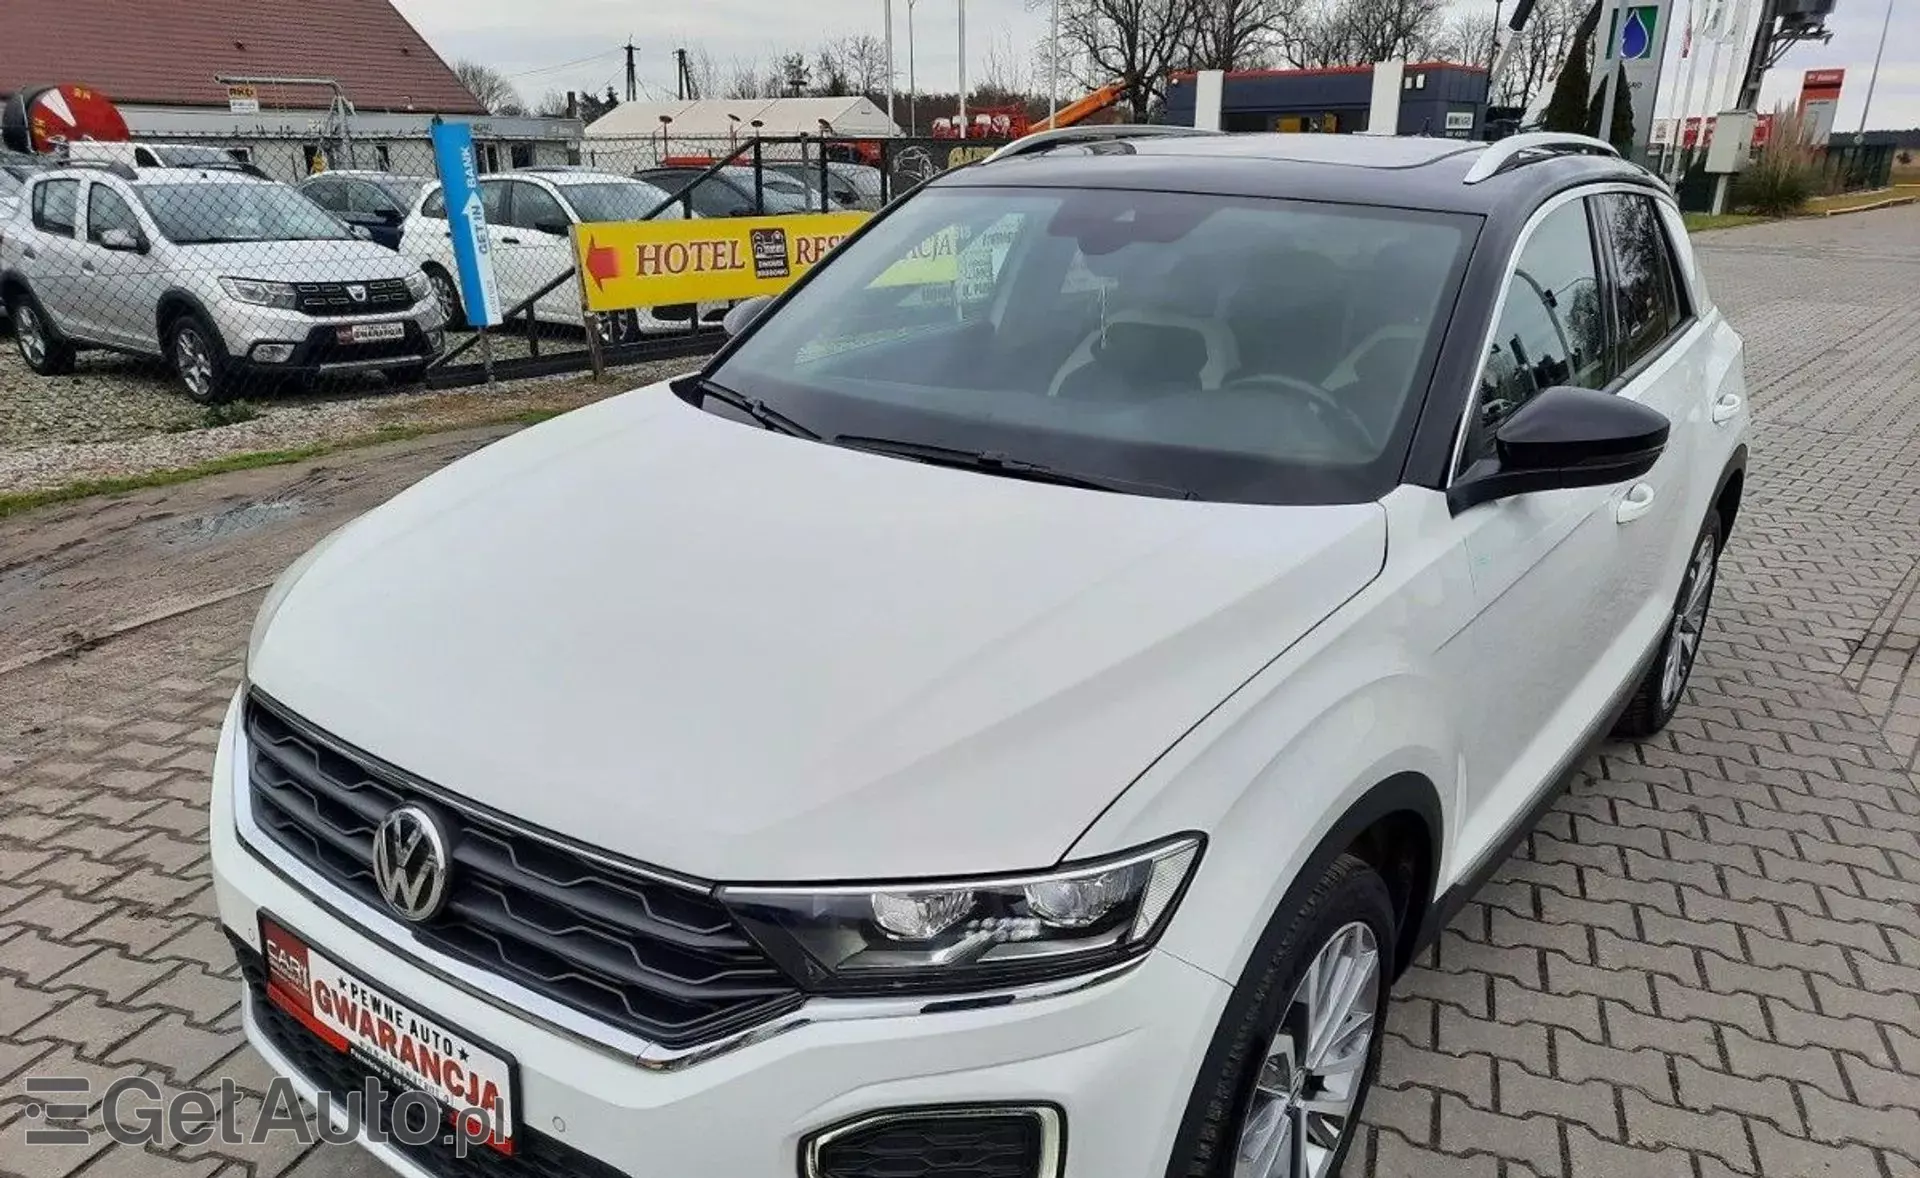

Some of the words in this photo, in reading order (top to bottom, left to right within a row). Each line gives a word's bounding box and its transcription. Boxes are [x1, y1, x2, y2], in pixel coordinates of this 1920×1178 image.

[461, 146, 476, 189] BANK
[636, 240, 745, 276] HOTEL
[313, 979, 500, 1112] GWARANCJA
[351, 983, 405, 1030] PEWNE
[410, 1019, 453, 1057] AUTO
